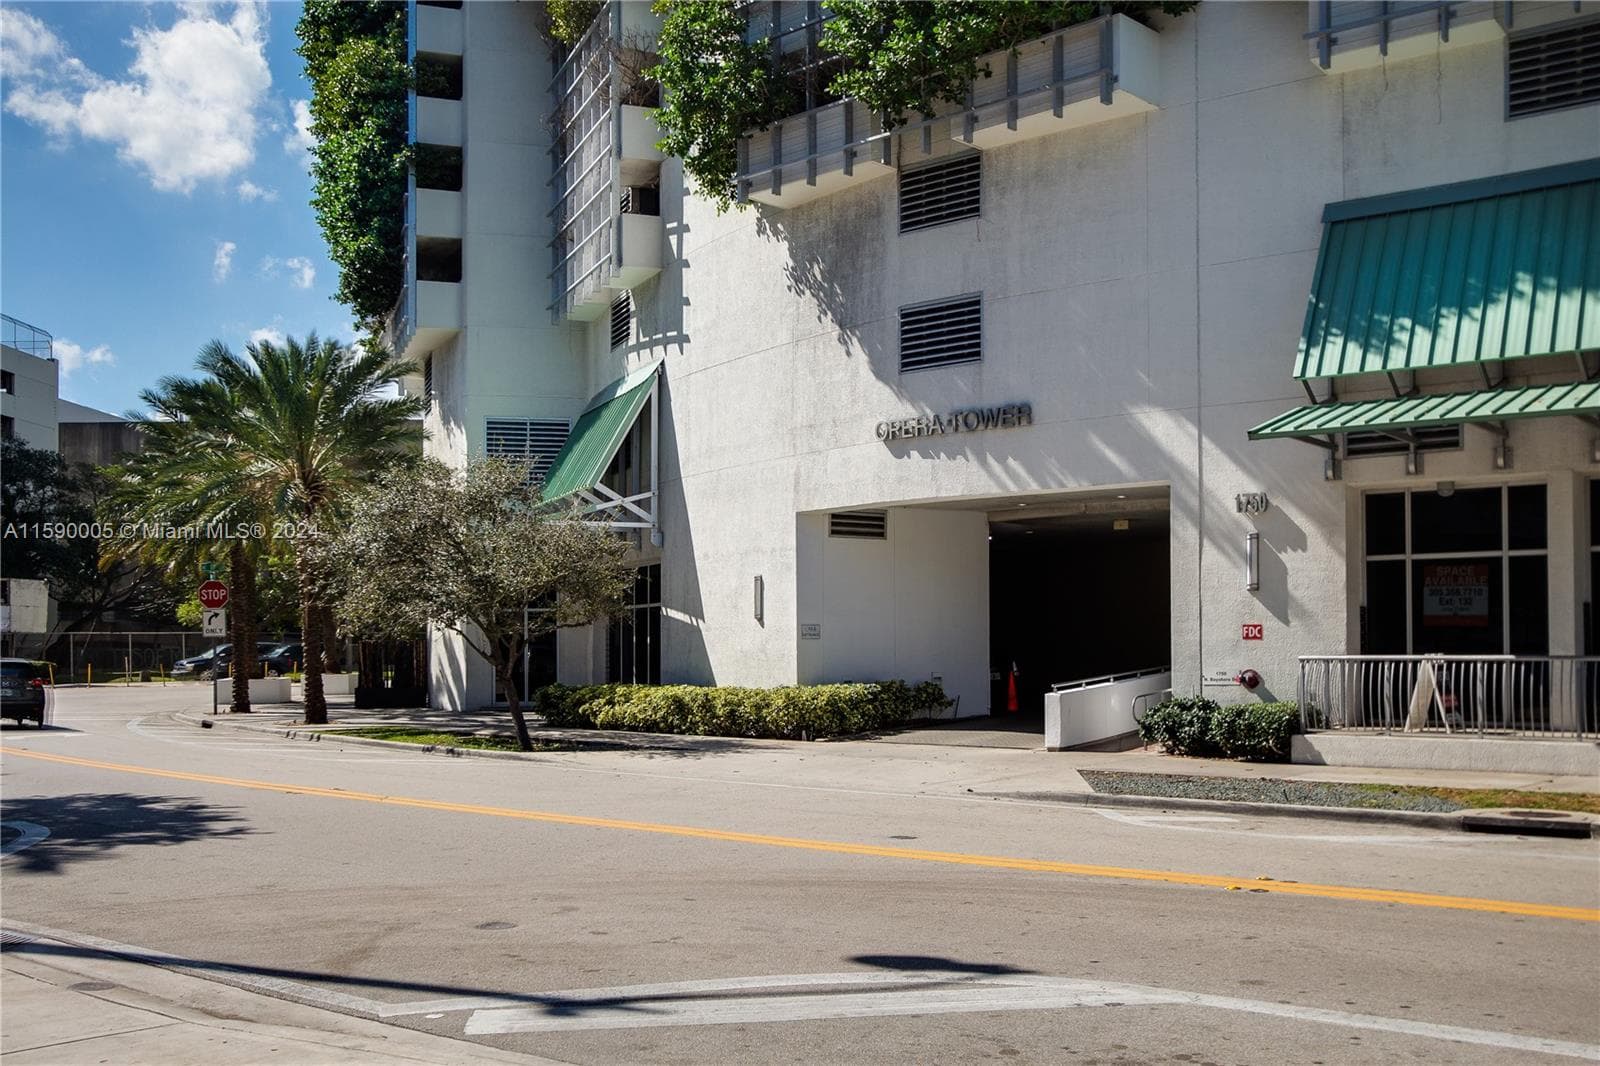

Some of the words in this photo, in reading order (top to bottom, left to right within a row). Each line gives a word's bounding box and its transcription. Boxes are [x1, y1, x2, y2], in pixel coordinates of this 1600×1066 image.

[875, 413, 944, 441] OPERA
[947, 400, 1033, 433] TOWER
[1436, 566, 1474, 576] SPACE
[1424, 576, 1488, 585] AVAILABLE
[201, 589, 226, 600] STOP
[1243, 626, 1261, 638] FDC
